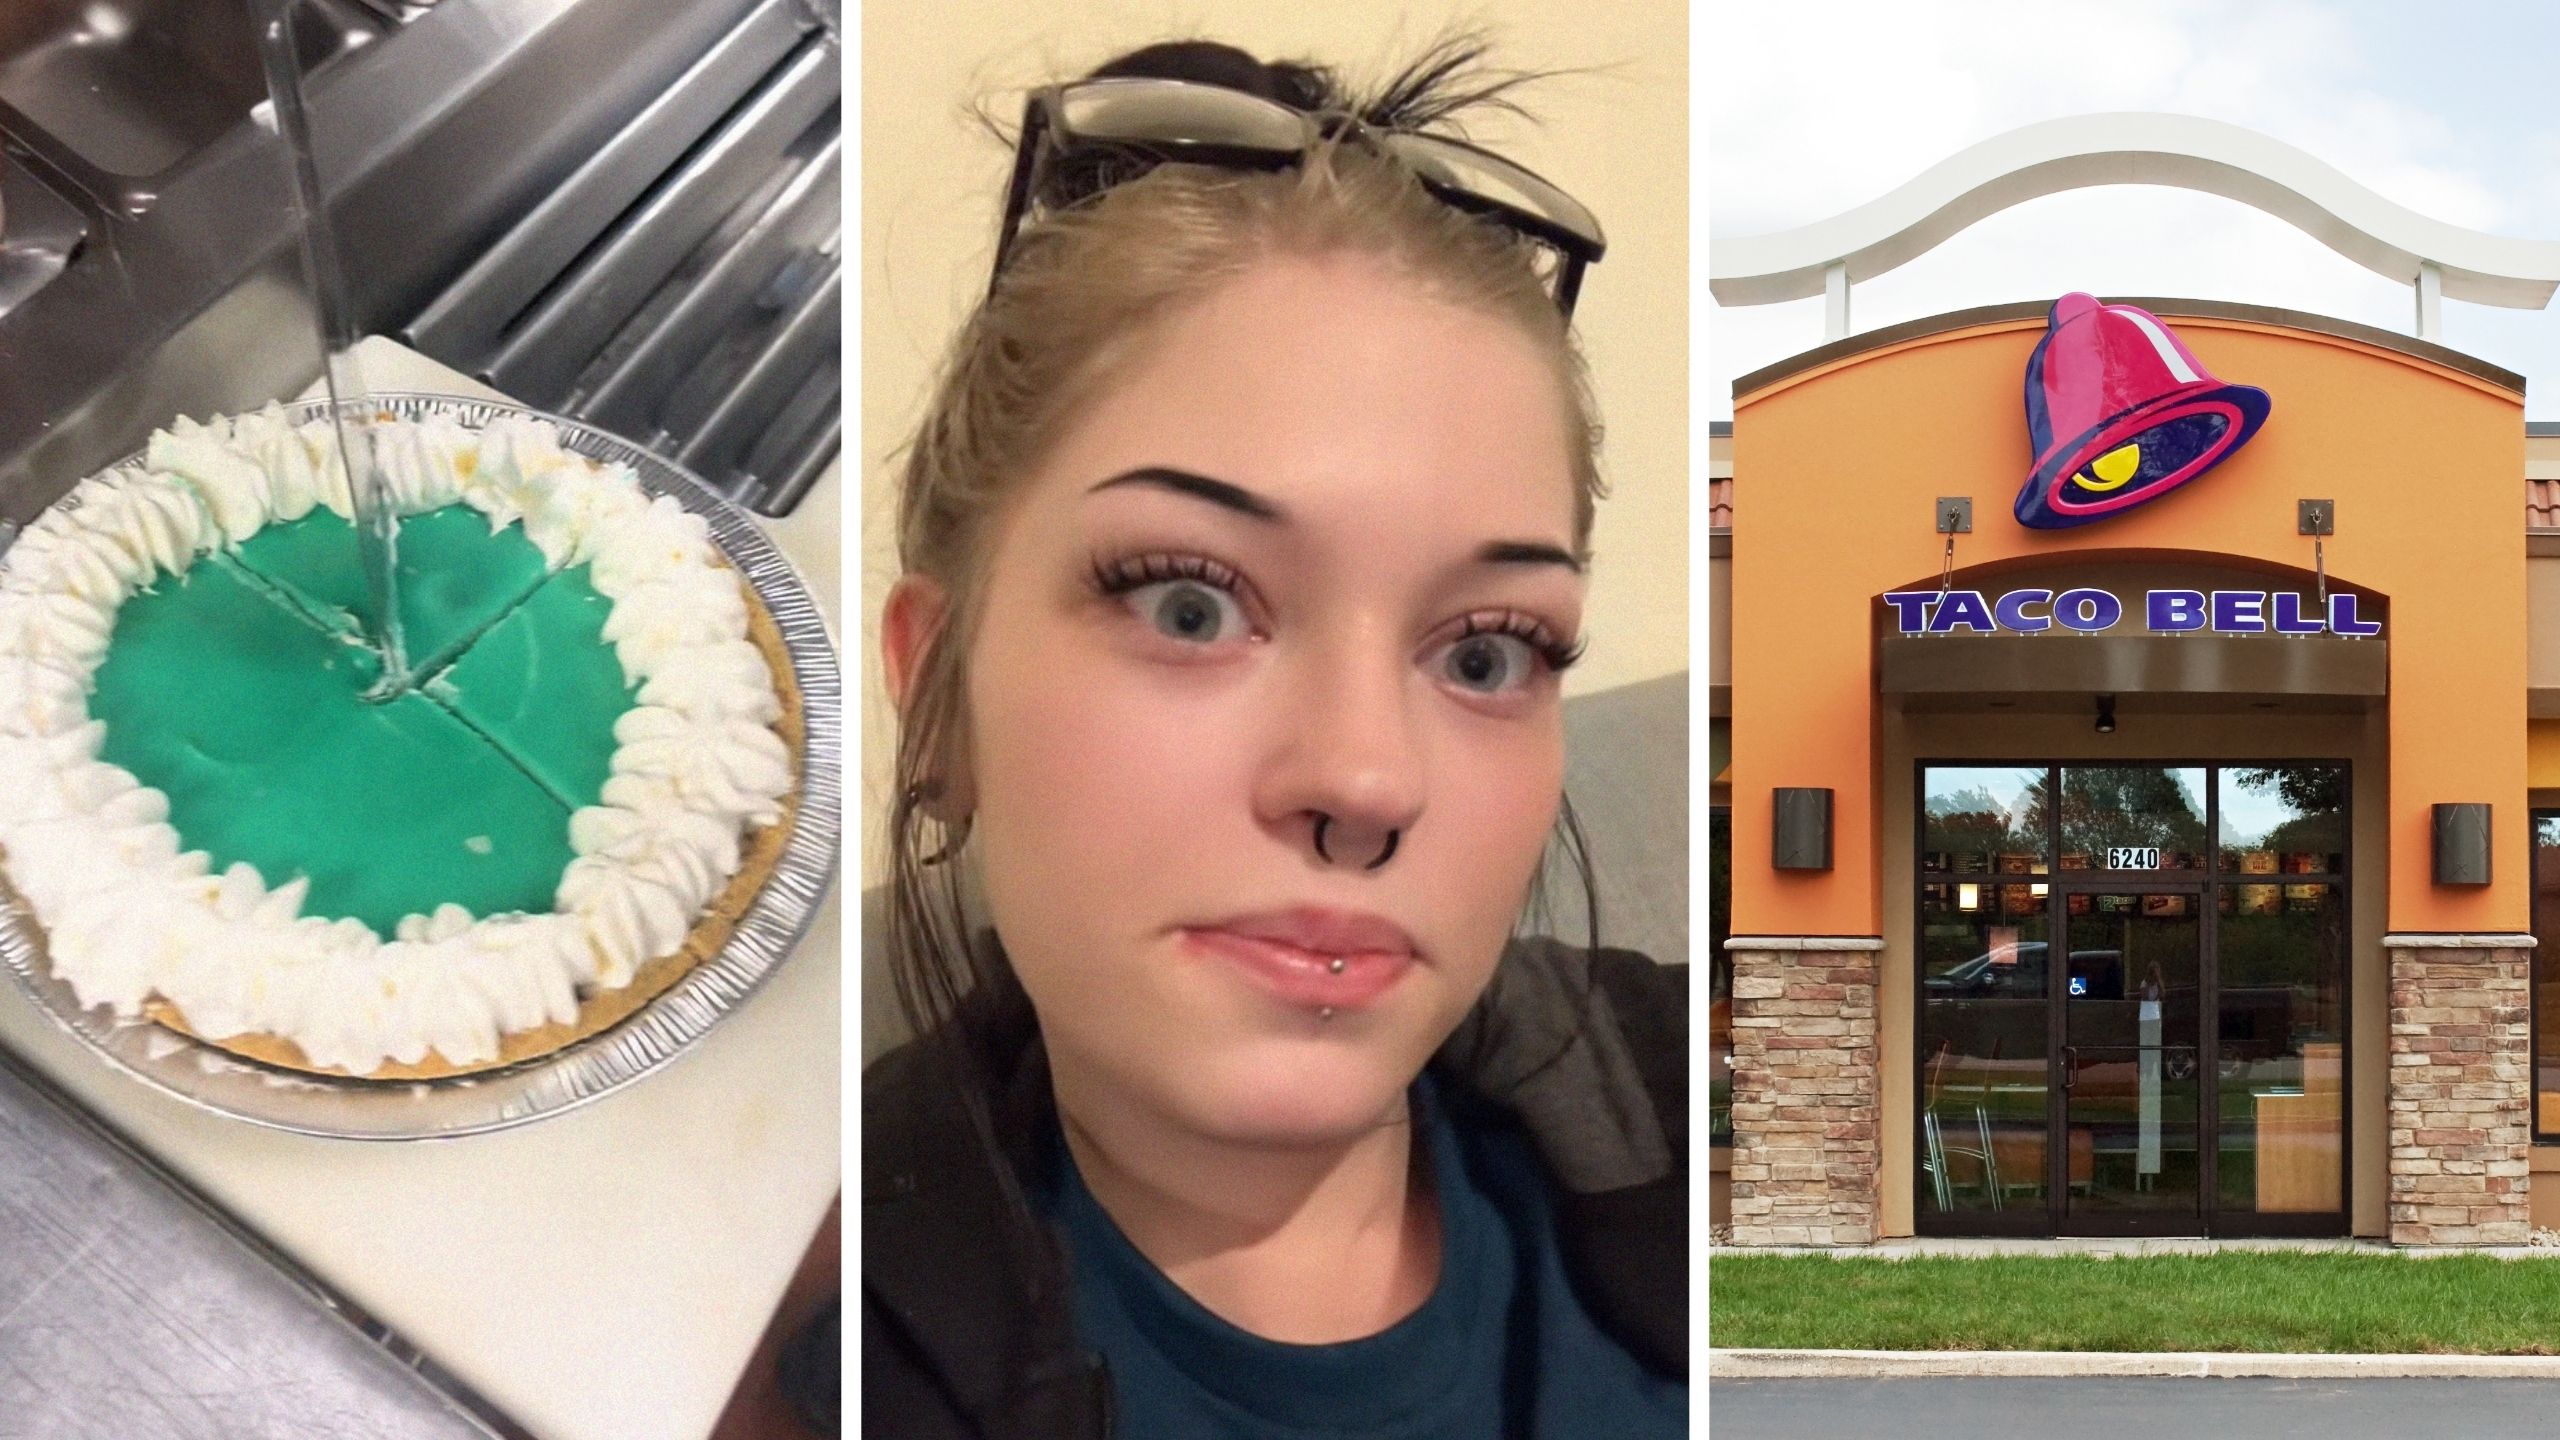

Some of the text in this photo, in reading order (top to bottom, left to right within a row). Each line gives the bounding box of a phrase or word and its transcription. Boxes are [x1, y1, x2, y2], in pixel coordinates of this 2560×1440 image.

[1884, 589, 2382, 635] TACO BELL
[2109, 848, 2158, 869] 6240
